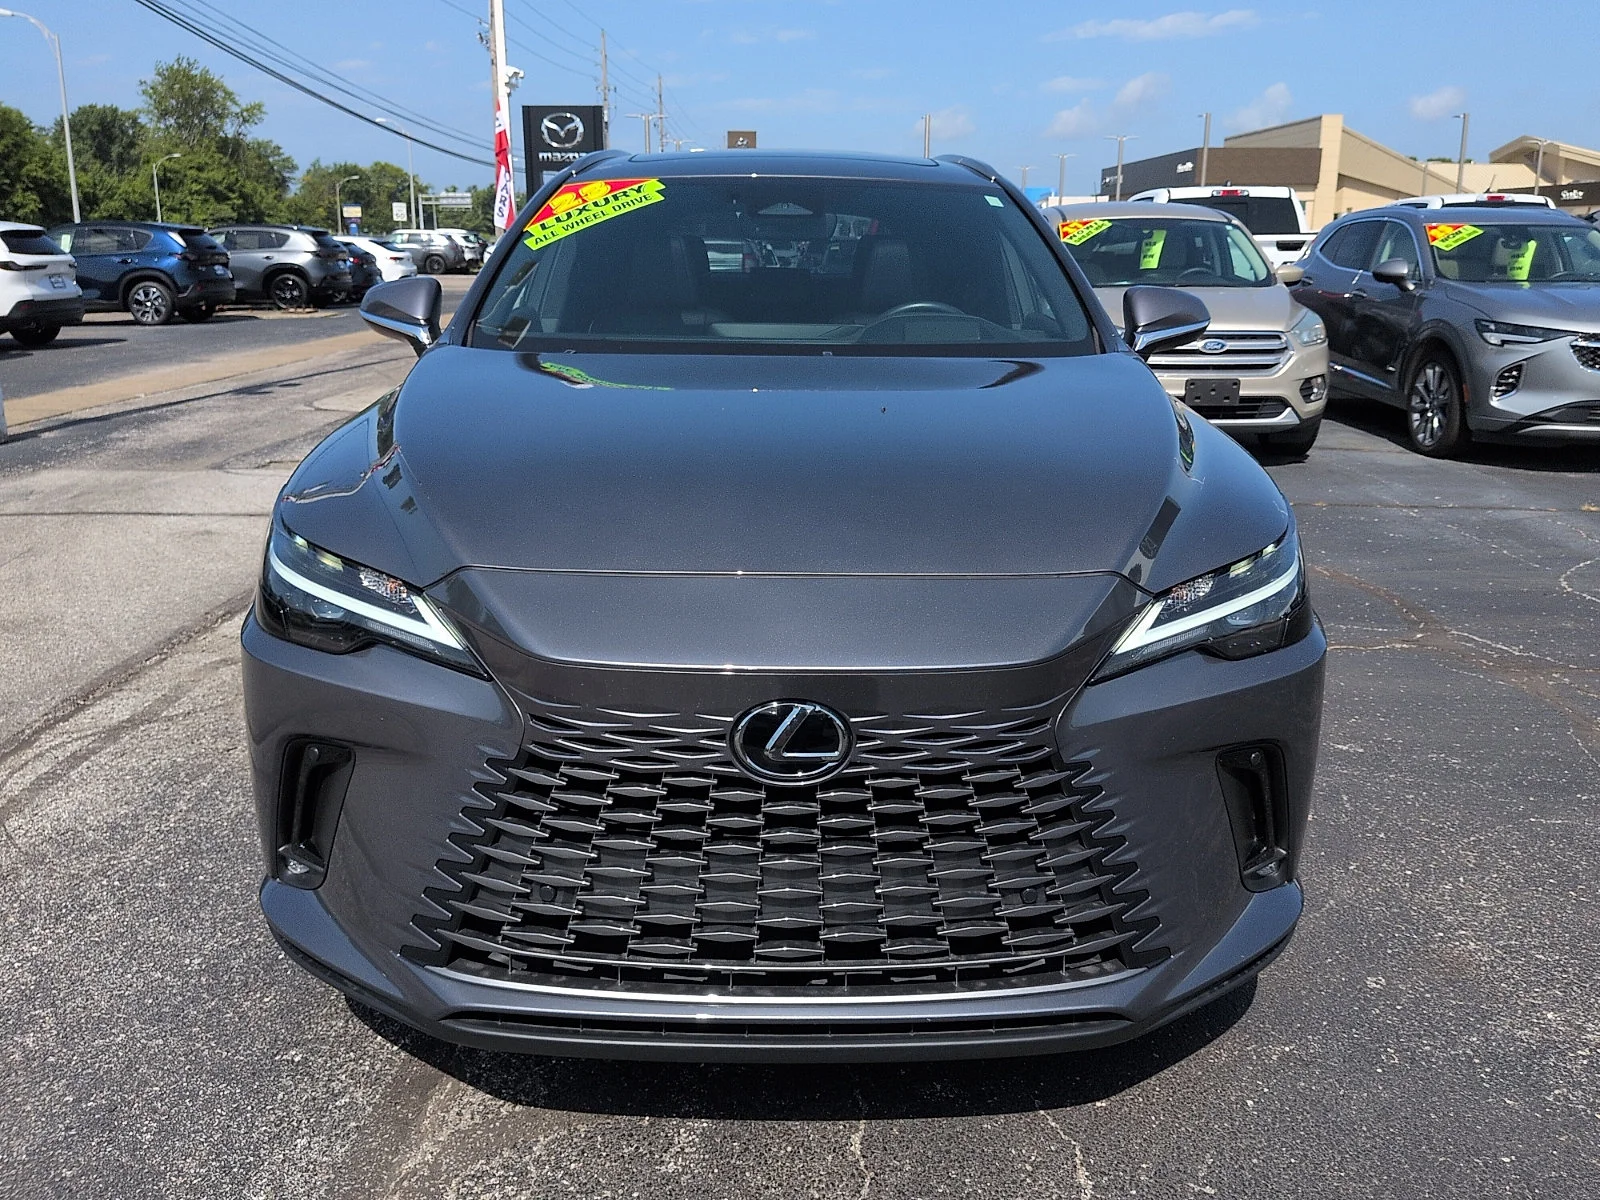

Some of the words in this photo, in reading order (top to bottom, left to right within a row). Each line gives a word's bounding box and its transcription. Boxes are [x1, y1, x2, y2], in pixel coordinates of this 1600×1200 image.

[534, 230, 559, 245] ALL
[562, 210, 608, 231] WHEEL
[612, 193, 652, 212] DRIVE
[539, 184, 645, 231] LUXURY
